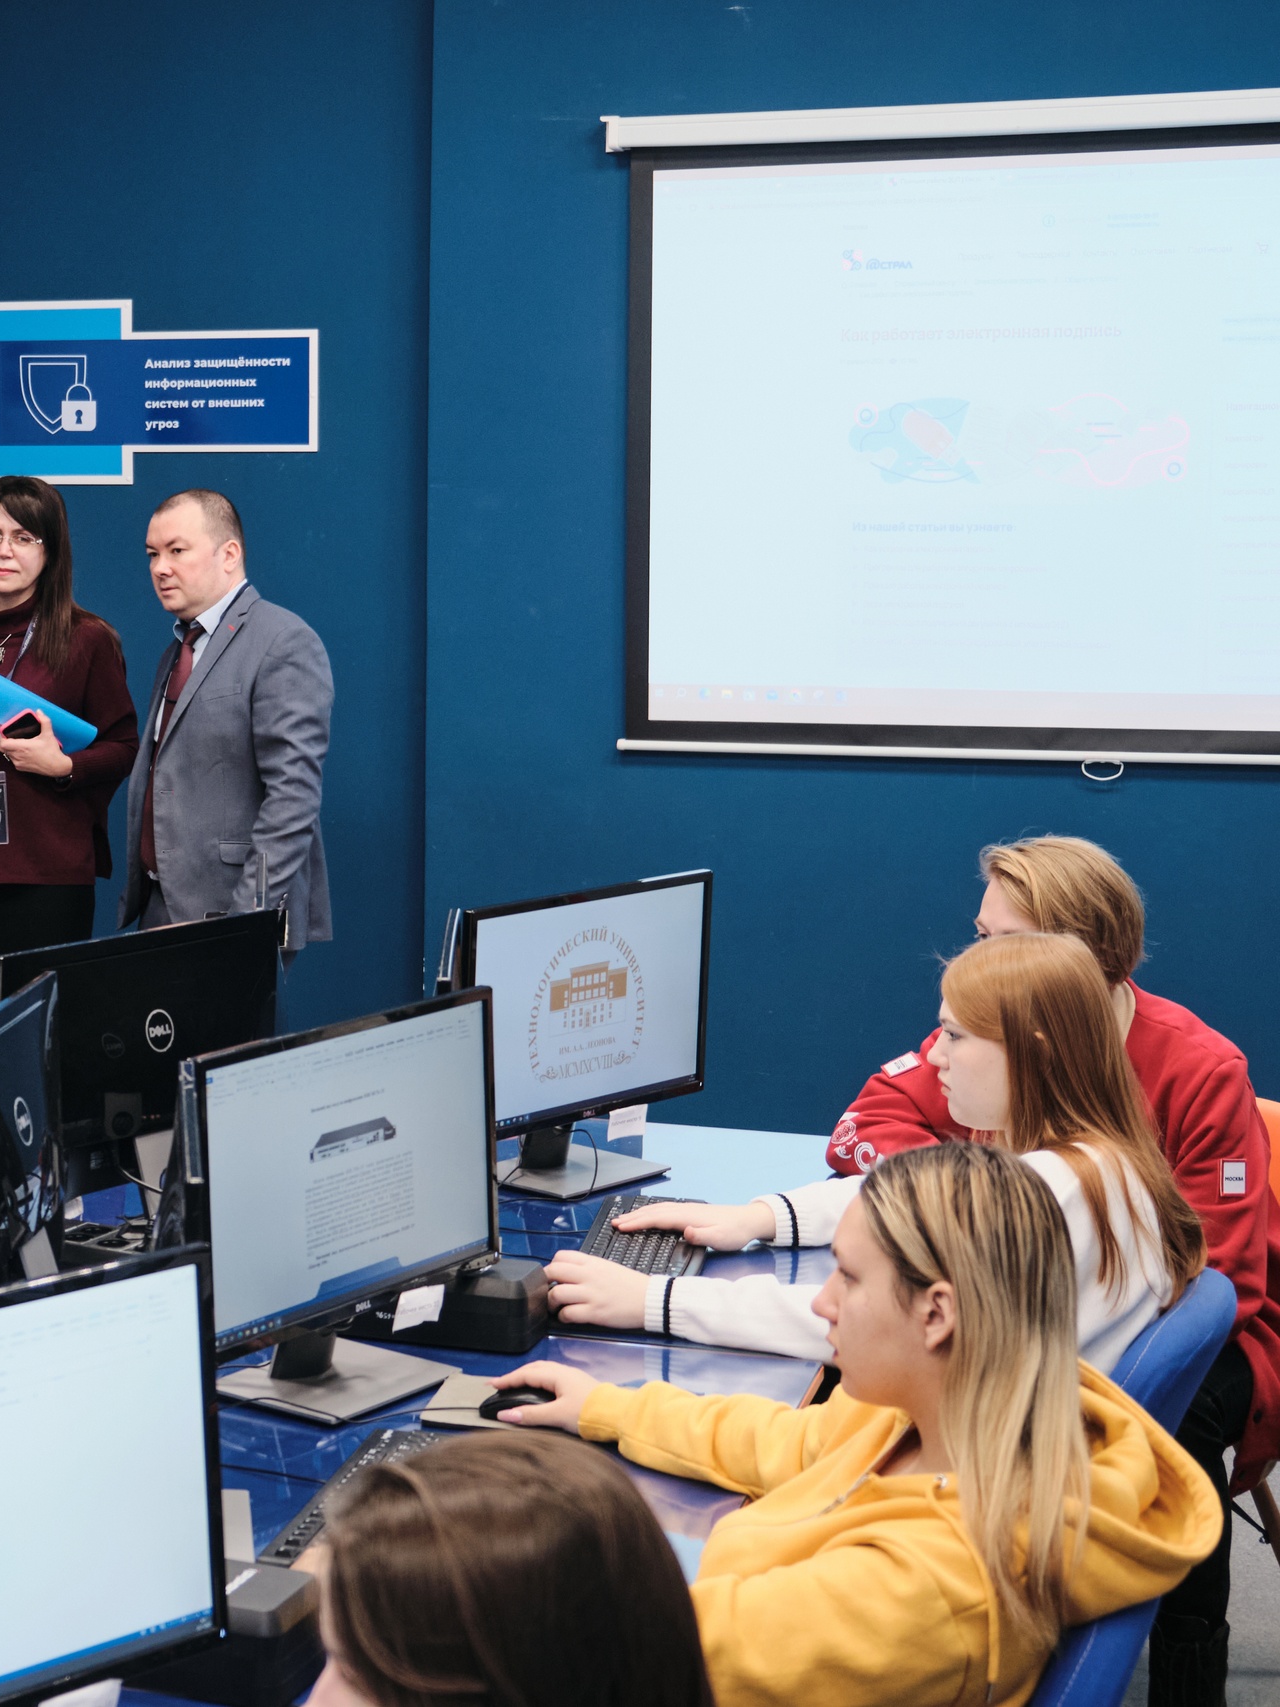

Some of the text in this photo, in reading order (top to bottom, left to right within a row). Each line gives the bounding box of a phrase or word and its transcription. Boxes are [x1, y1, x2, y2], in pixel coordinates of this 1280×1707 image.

[840, 325, 1122, 345] Как работает электронная подпись
[144, 356, 291, 369] Анализ защищённости
[144, 377, 257, 390] информационных
[144, 397, 265, 409] систем от внешних
[145, 419, 180, 431] угроз
[852, 522, 866, 532] Из
[869, 521, 906, 533] нашей
[907, 522, 947, 532] статьи
[949, 523, 964, 532] вы
[528, 926, 609, 1073] ТЕХНОЛОГИЧЕСКИЙ
[610, 931, 645, 1047] УНИВЕРСИТЕТ
[148, 1023, 172, 1038] DELL
[355, 1300, 372, 1313] DELL
